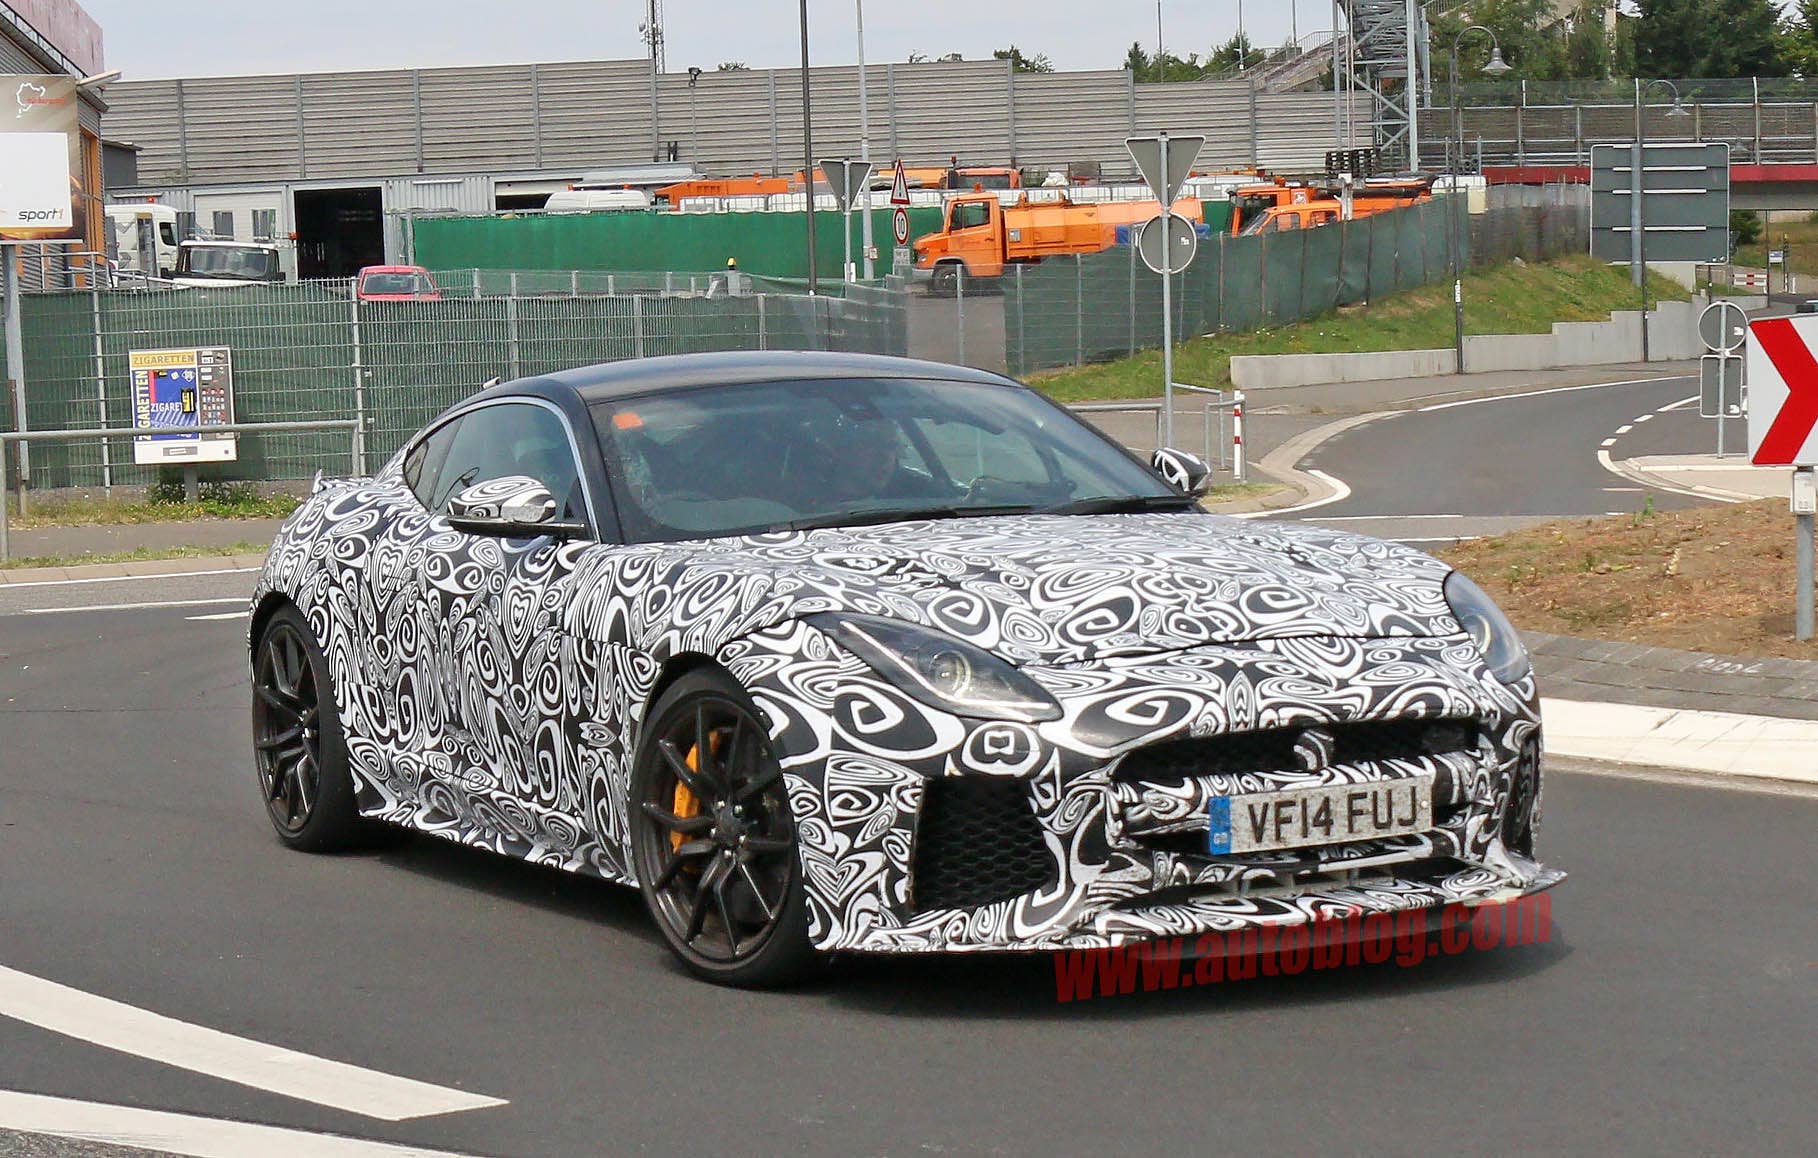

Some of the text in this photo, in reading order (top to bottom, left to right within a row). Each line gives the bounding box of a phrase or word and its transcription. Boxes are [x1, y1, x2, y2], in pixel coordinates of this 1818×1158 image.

[18, 207, 64, 222] sport1
[897, 216, 905, 235] 10
[133, 353, 195, 364] ZIGARETTEN
[135, 370, 152, 441] ZGARETTEN
[1247, 786, 1417, 844] VF14 FUJ
